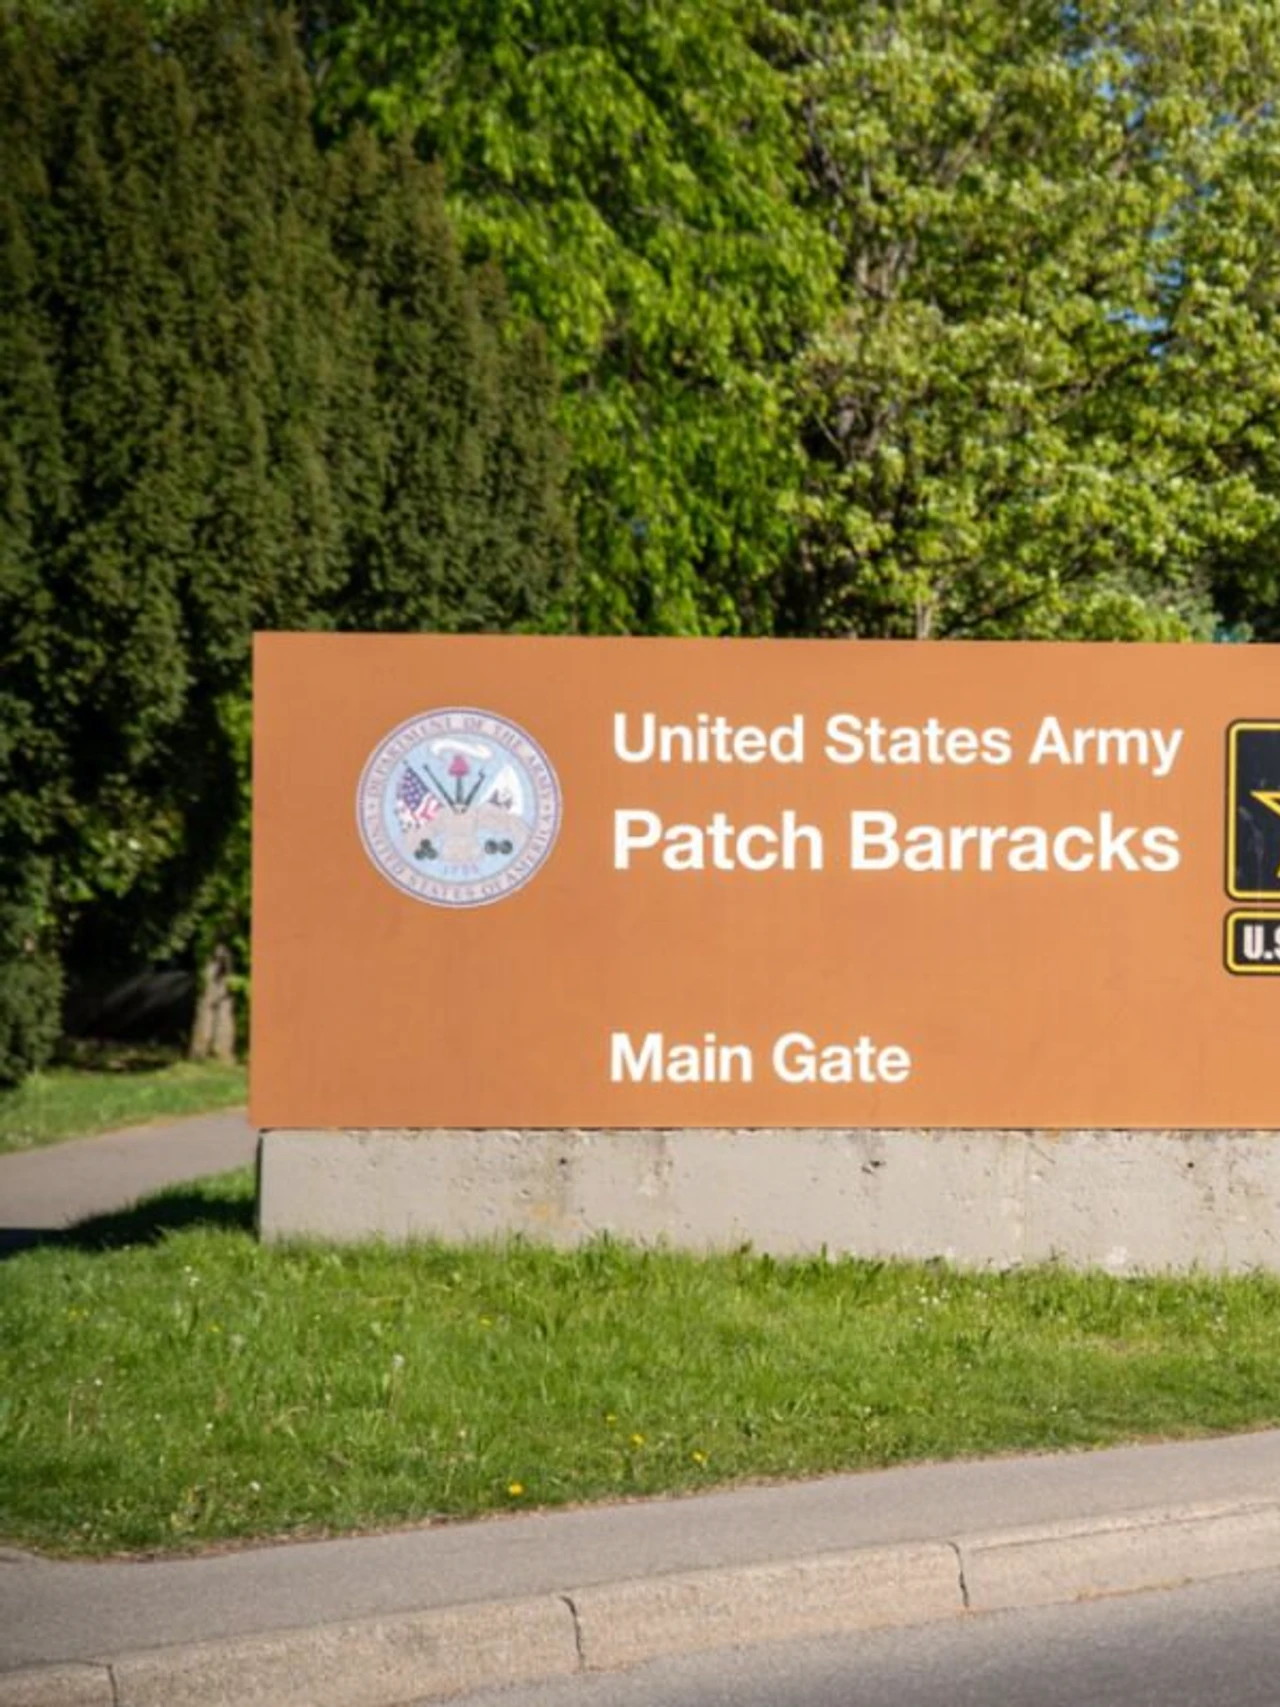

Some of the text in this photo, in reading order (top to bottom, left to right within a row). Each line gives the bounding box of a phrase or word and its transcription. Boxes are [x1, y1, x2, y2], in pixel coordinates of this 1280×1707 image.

[612, 712, 1185, 778] United States Army
[612, 808, 1182, 873] Patch Barracks
[610, 1031, 912, 1084] Main Gate
